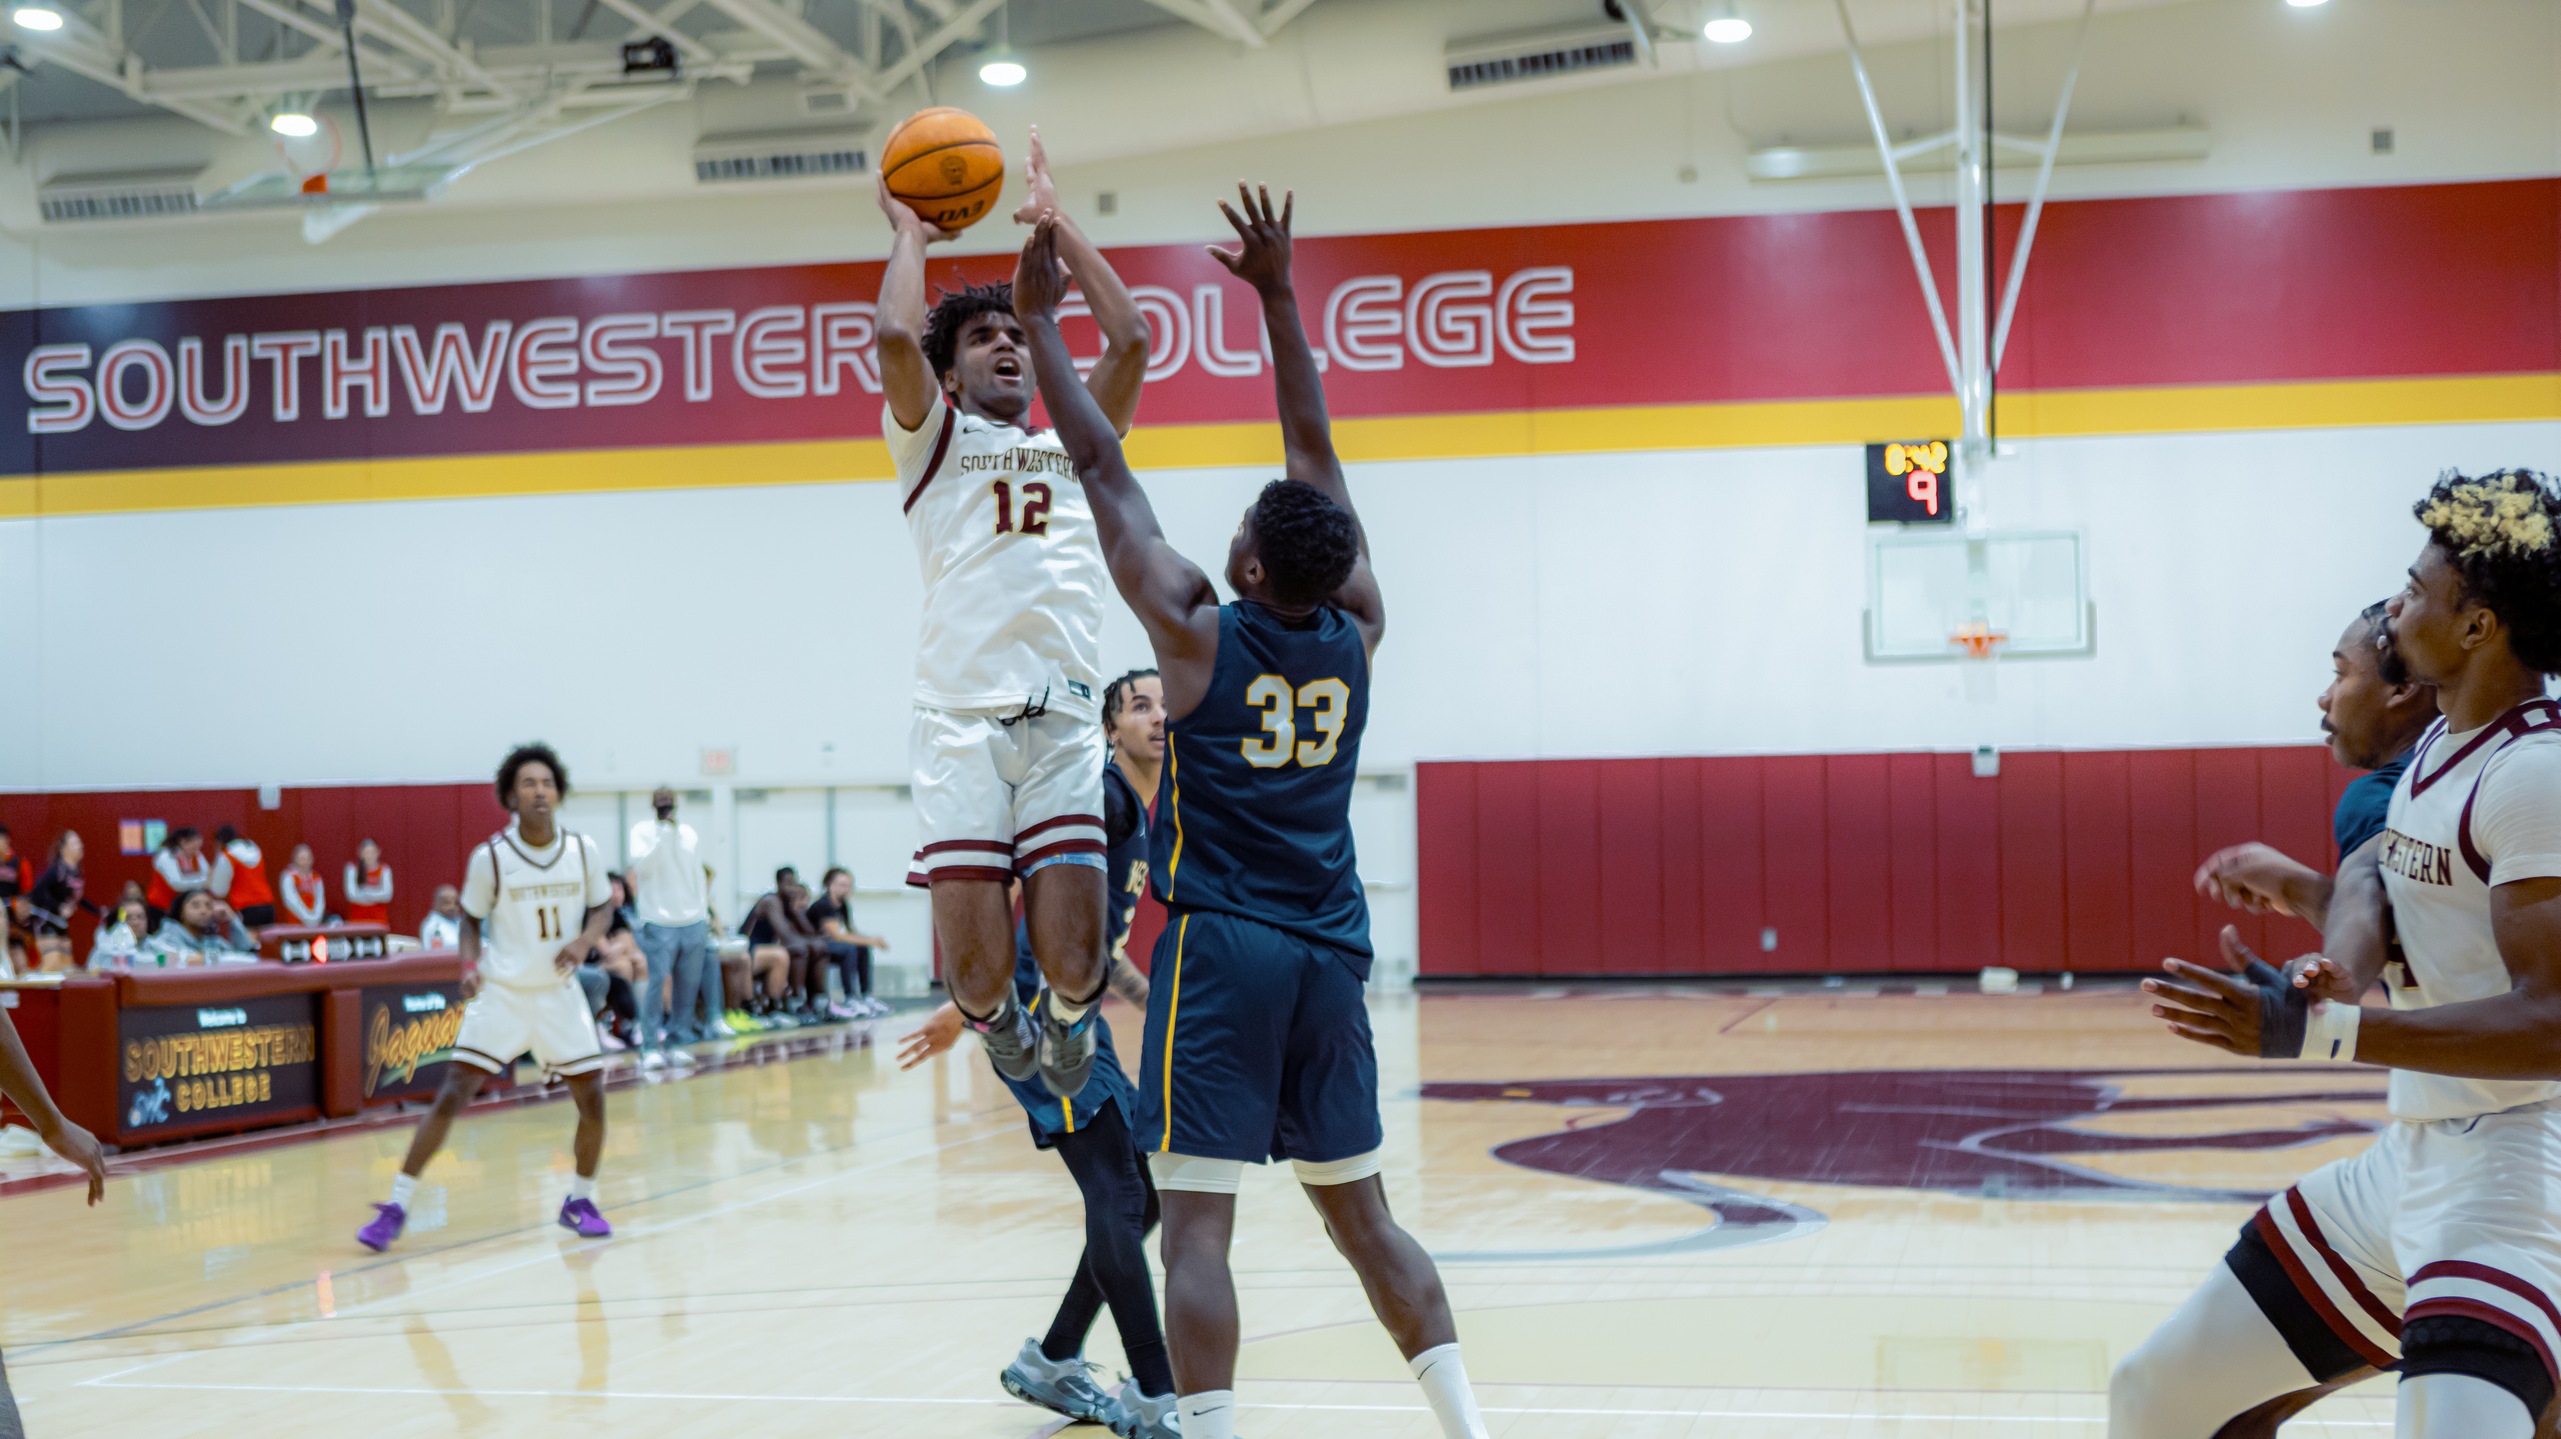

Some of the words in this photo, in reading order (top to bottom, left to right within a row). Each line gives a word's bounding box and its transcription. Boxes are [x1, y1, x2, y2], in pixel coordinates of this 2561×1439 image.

[24, 301, 884, 434] SOUTHWESTER
[1053, 266, 1576, 383] OLEGE
[992, 478, 1052, 538] 12
[1907, 469, 1938, 516] 9
[1241, 674, 1350, 768] 33
[536, 905, 561, 941] 11
[125, 1024, 315, 1083] SOUTHWESTERN
[175, 1068, 271, 1112] COLLEGE
